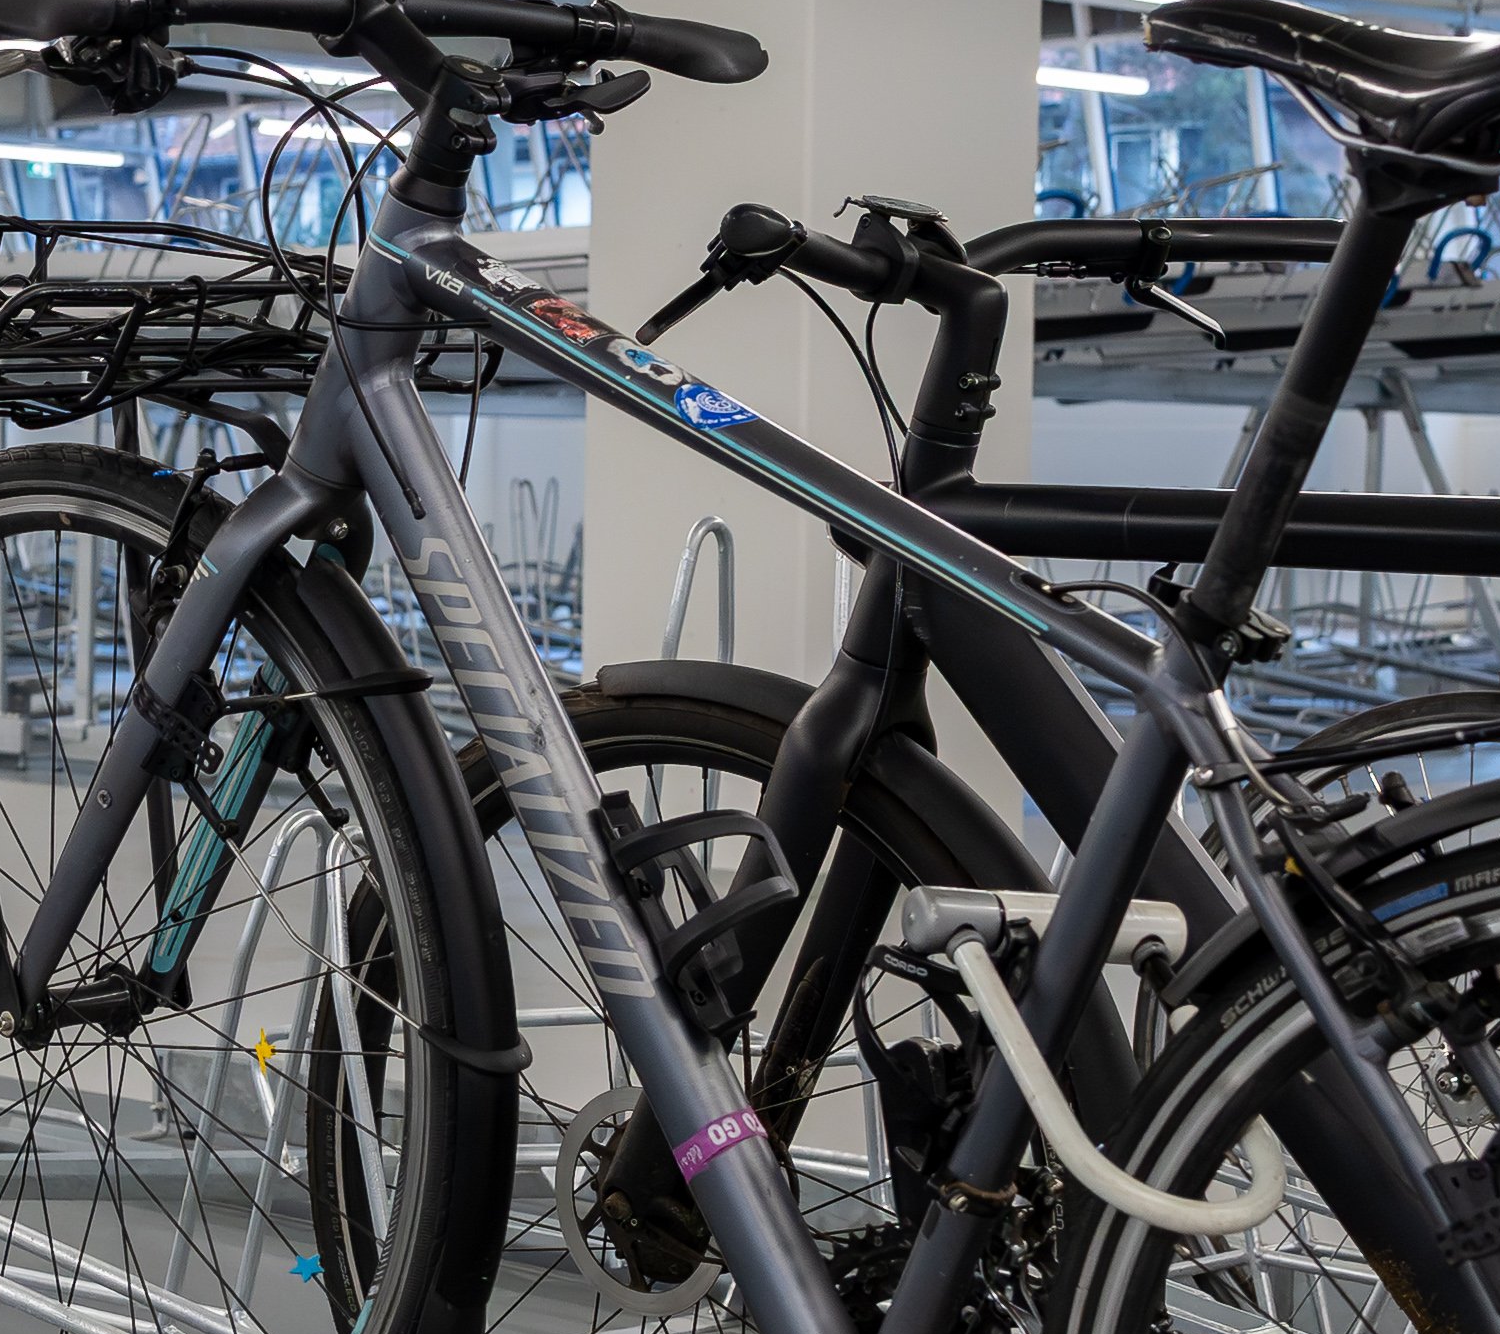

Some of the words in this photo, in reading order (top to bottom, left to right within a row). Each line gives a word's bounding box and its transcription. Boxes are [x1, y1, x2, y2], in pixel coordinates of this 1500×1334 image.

[425, 264, 465, 295] vita
[403, 535, 656, 1000] SPECIALIZED
[883, 953, 929, 978] CORDO
[1220, 925, 1348, 1030] SCHWBE
[707, 1116, 742, 1147] GO
